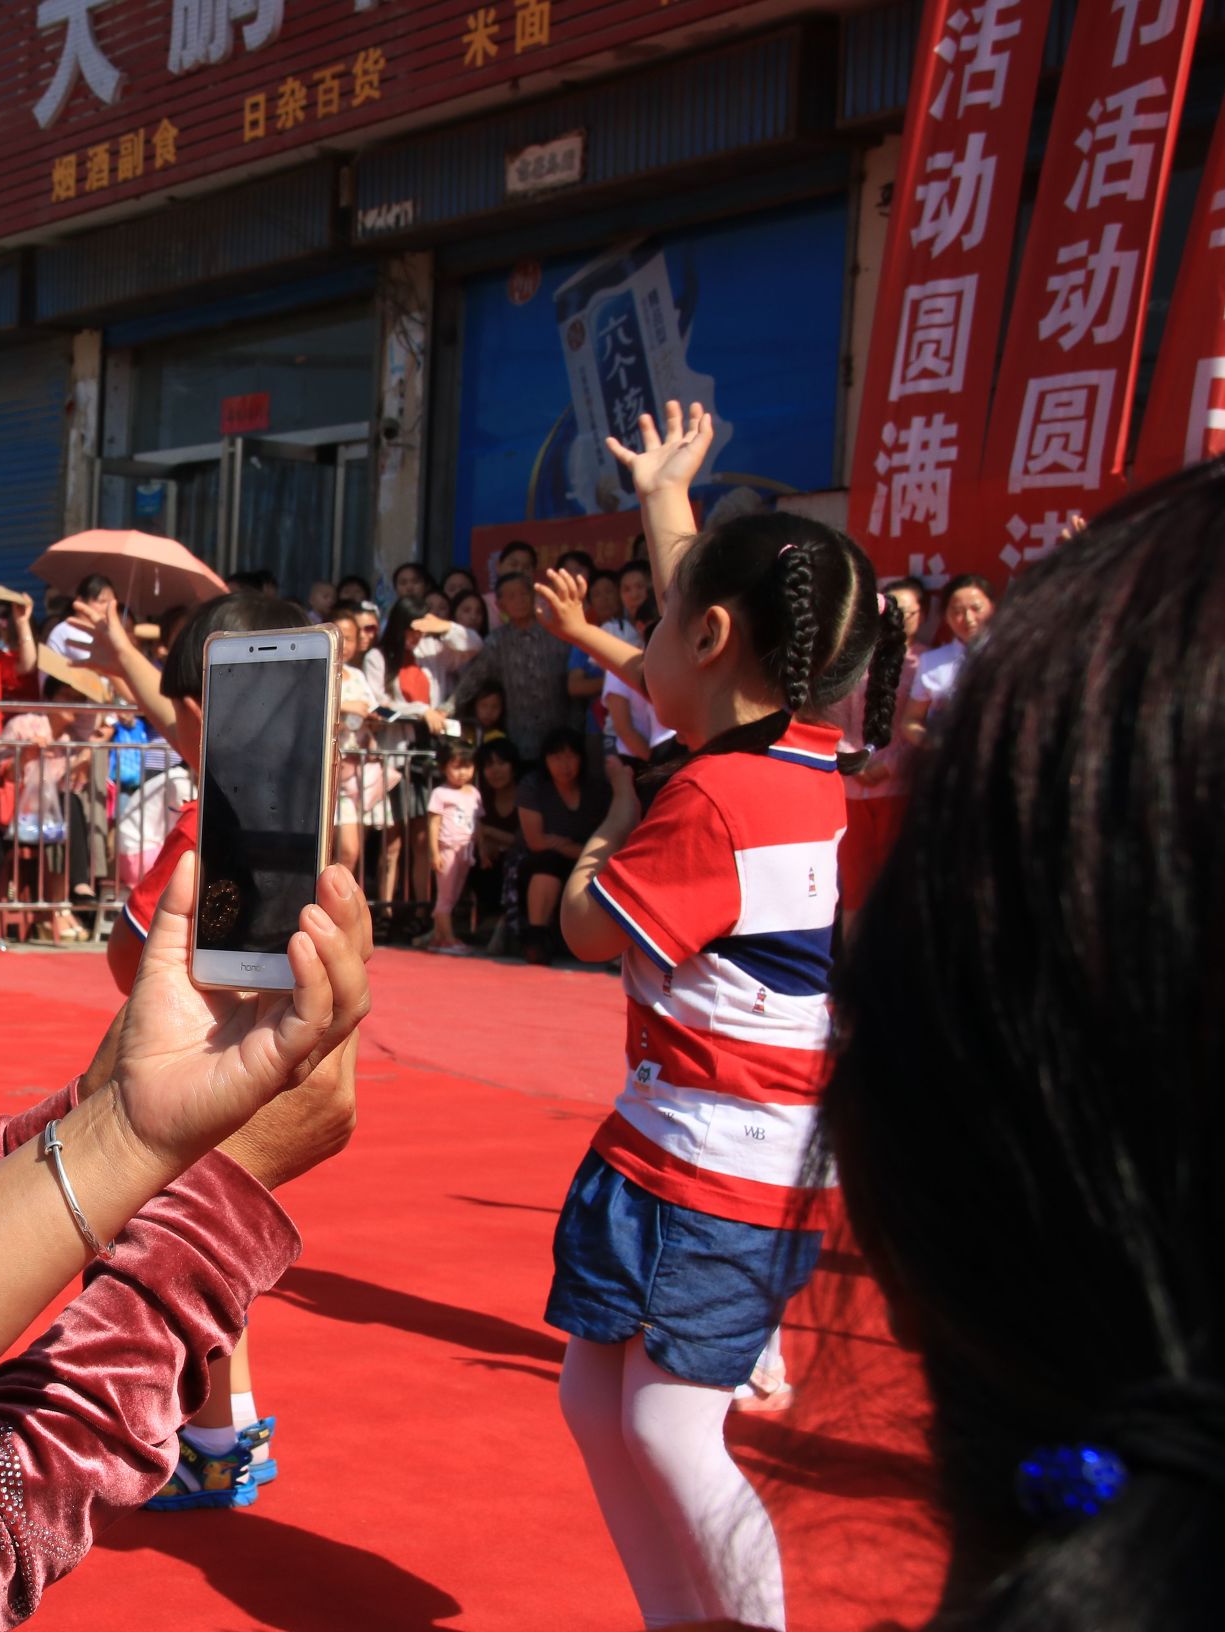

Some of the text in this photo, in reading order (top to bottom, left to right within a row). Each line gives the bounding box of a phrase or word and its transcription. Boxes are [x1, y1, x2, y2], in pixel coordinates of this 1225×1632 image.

[51, 0, 553, 203] 烟酒副食 日杂百货 米面
[597, 313, 644, 453] 六个核
